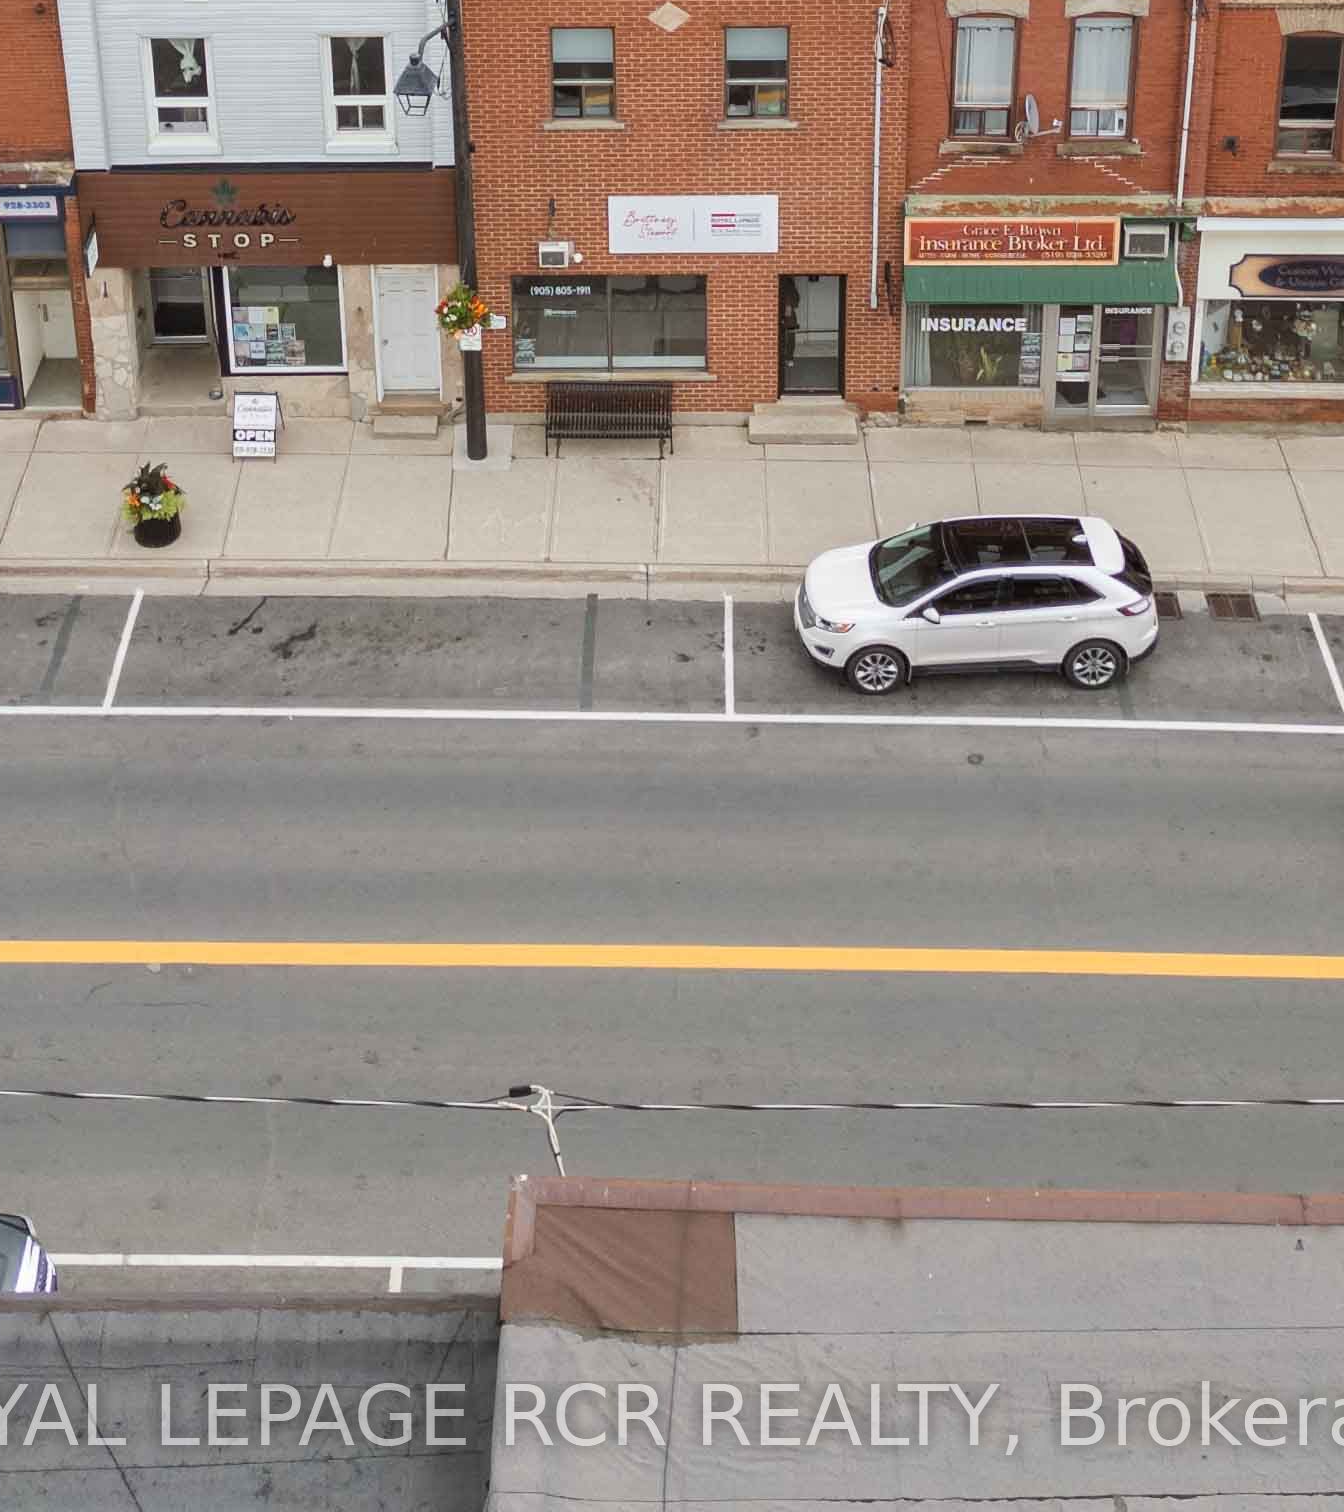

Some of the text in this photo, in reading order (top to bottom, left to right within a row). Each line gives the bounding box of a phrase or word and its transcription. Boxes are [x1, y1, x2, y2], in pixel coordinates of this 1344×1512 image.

[159, 199, 297, 229] Cannabis
[962, 224, 999, 236] Grace
[1019, 224, 1062, 237] Brown
[183, 234, 274, 248] STOP
[919, 235, 1002, 251] Insurance
[1008, 234, 1069, 251] Broker
[530, 286, 553, 296] (905)
[1104, 307, 1152, 315] INSURANCE
[920, 317, 1028, 332] INSURANCE
